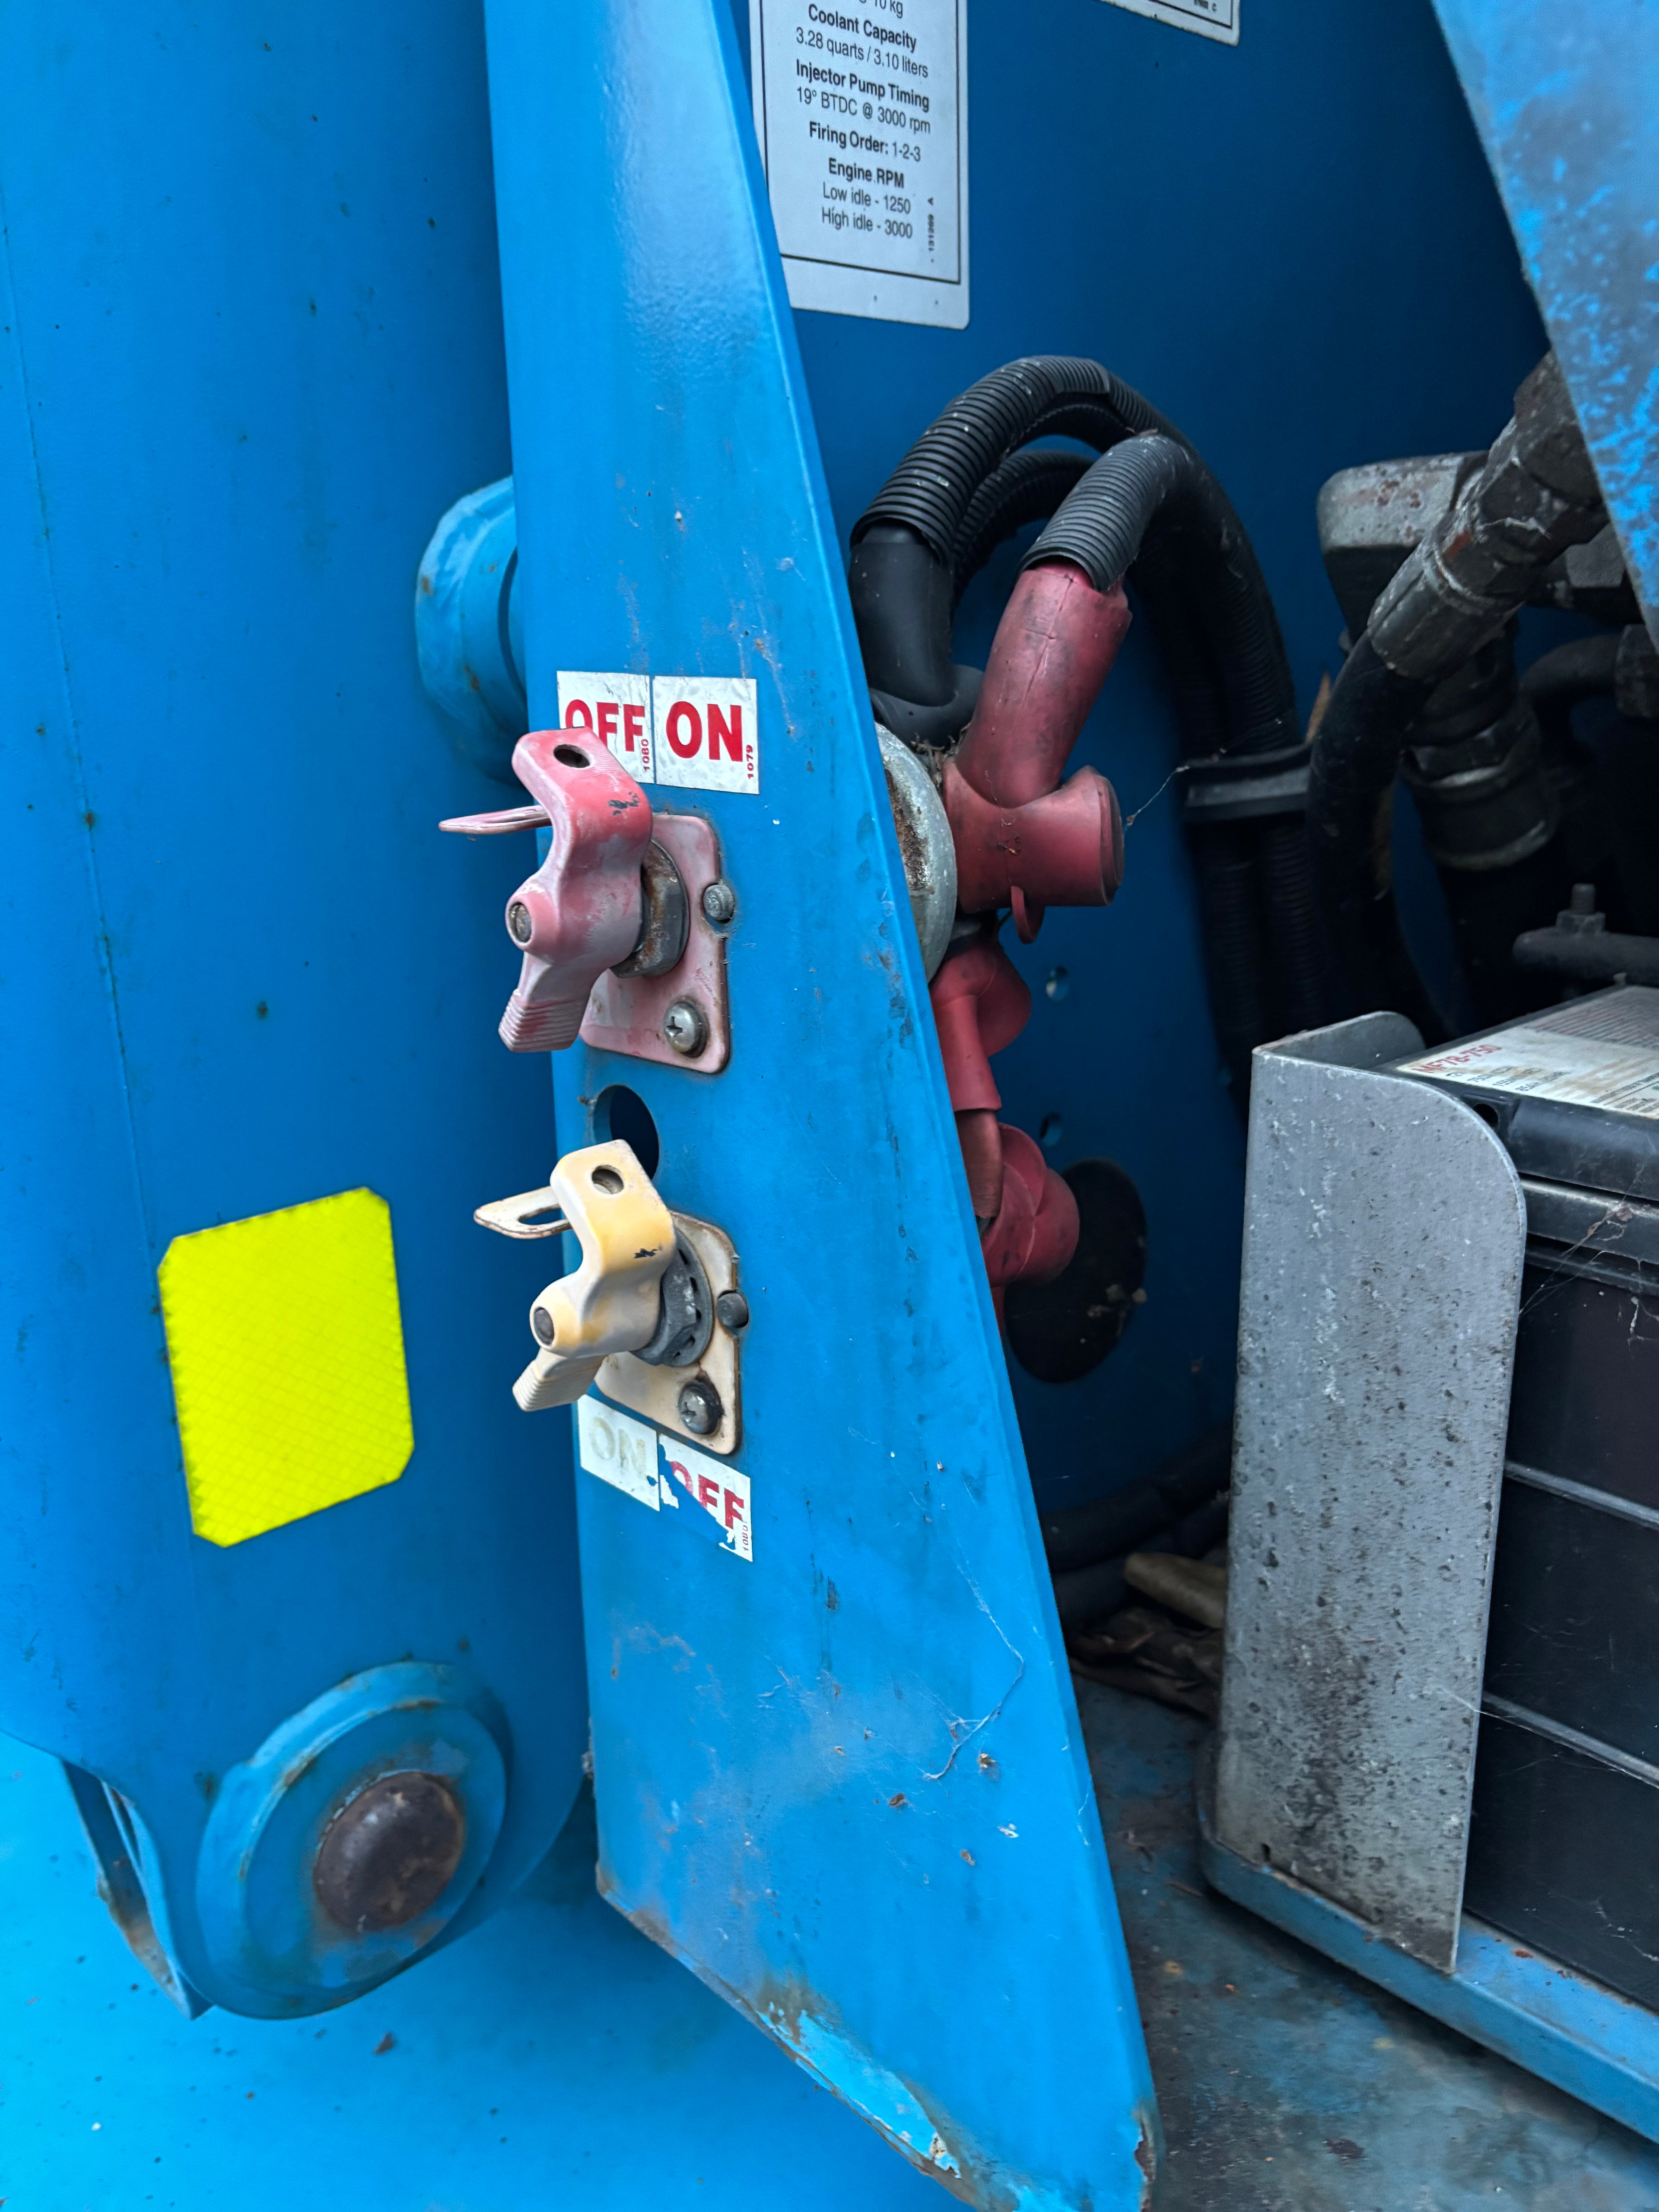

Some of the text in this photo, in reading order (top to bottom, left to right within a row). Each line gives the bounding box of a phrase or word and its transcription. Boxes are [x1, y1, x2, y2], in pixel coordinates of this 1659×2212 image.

[808, 4, 916, 52] Coolant Capacity
[797, 27, 823, 49] 3.28
[827, 38, 864, 61] quarts
[874, 50, 899, 70] 3.10
[902, 56, 928, 78] liters
[797, 59, 929, 112] Injector Pump Timing
[821, 92, 857, 115] BTDC
[863, 102, 872, 119] @
[878, 107, 906, 127] 3000
[909, 118, 930, 134] rpm
[810, 121, 920, 162] Firing Order: 1-2-3
[829, 158, 904, 188] Engine RPM
[823, 182, 847, 200] Low
[851, 187, 871, 206] idle
[884, 196, 911, 214] 1250
[822, 206, 849, 230] High
[853, 214, 873, 231] idle
[885, 220, 912, 238] 3000
[565, 699, 645, 752] OFF
[666, 701, 743, 762] ON
[641, 738, 649, 772] 1080
[746, 744, 754, 779] 1079
[589, 1417, 646, 1478] ON
